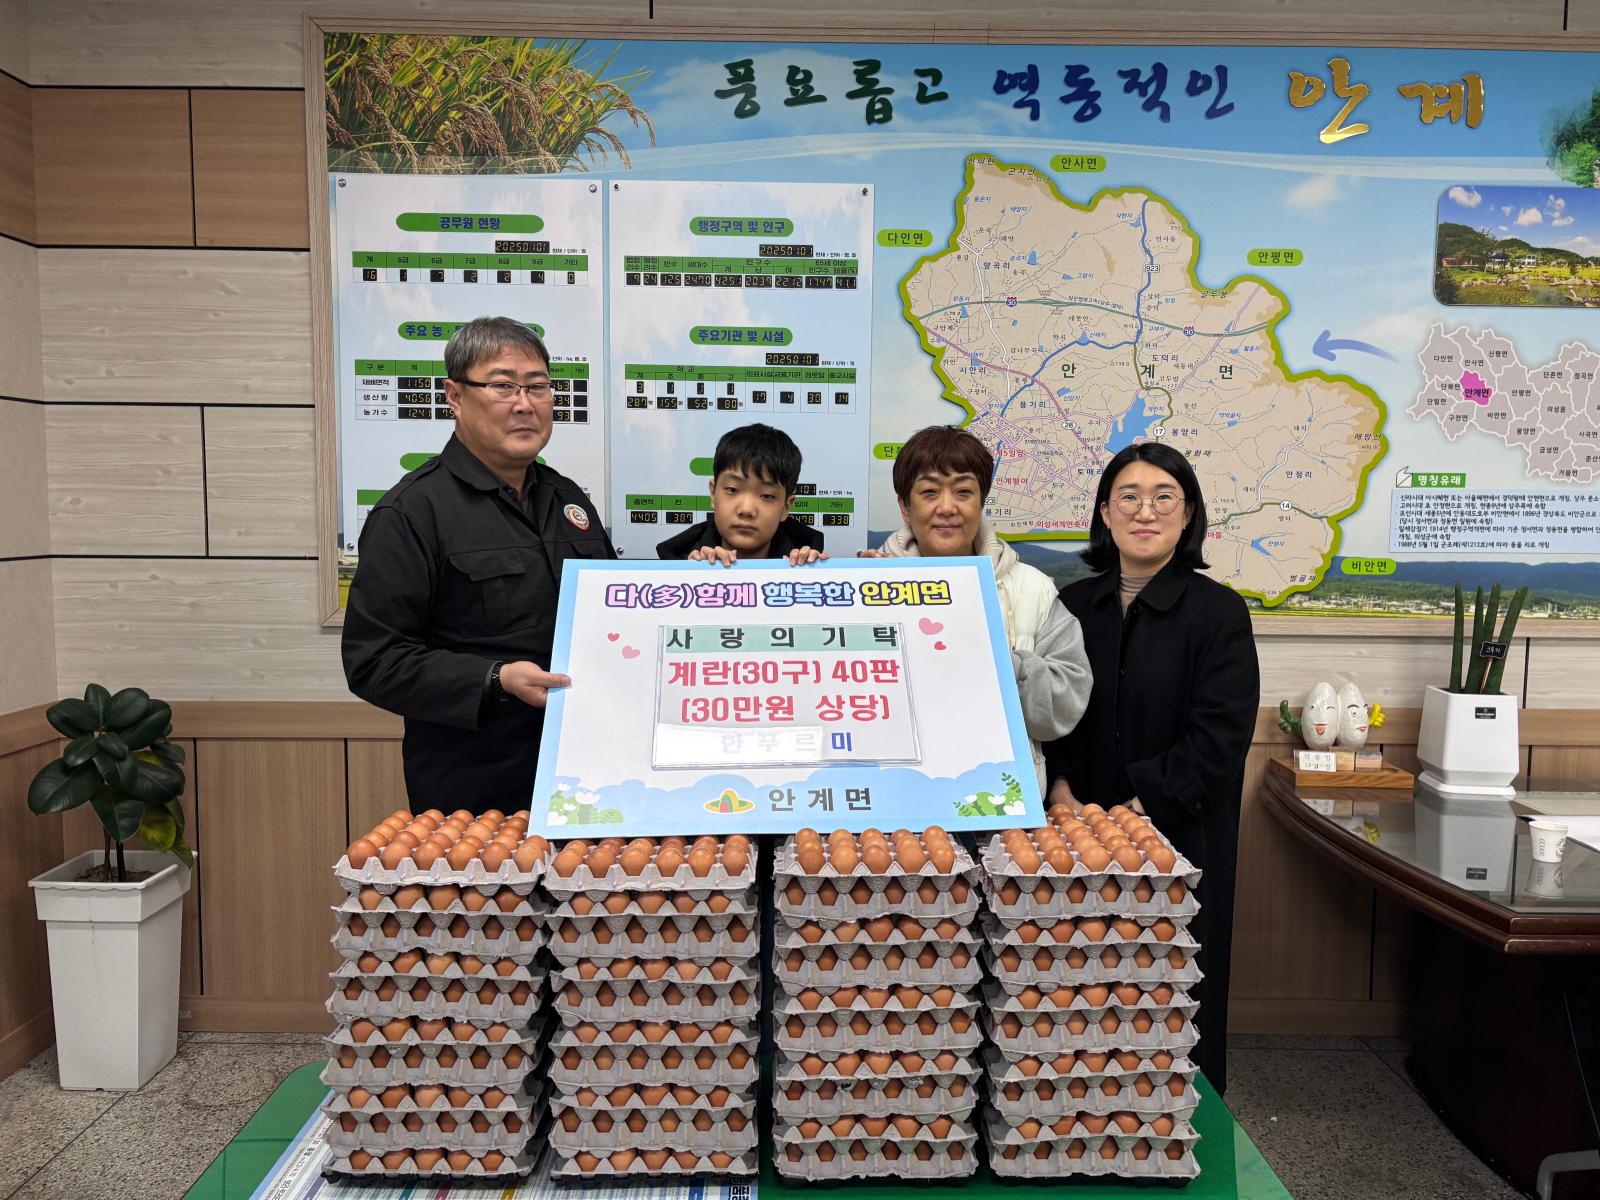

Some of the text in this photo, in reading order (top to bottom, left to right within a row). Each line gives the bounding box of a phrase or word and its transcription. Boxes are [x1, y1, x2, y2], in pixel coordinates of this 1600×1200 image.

[714, 58, 949, 125] 풍요롭고
[993, 62, 1235, 123] 역동적인
[1061, 157, 1097, 170] 안사면
[440, 216, 500, 230] 공무원 현황
[698, 220, 785, 233] 행정구역 및 인구
[887, 232, 922, 244] 다인면
[760, 245, 813, 256] 20250101
[563, 258, 578, 266] 기타
[1258, 252, 1294, 264] 안평면
[644, 274, 657, 284] 24
[685, 275, 711, 285] 2470
[745, 277, 772, 286] 2039
[405, 324, 427, 337] 주요
[698, 329, 784, 342] 주요기관 및 시설
[766, 354, 819, 365] 20250101
[1151, 354, 1178, 362] 도덕리
[1433, 355, 1453, 363] 다인면
[1464, 359, 1484, 367] 안사면
[1061, 363, 1233, 379] 안 계 면
[408, 379, 431, 388] 1150
[1440, 383, 1461, 391] 단북면
[405, 394, 431, 403] 4056
[809, 393, 821, 403] 30
[1464, 388, 1490, 398] 안계면
[1511, 389, 1531, 397] 안평면
[660, 398, 677, 408] 155
[694, 399, 707, 408] 52
[1427, 397, 1447, 406] 단밀면
[408, 408, 570, 421] 1241 93
[1449, 414, 1468, 422] 구천면
[1487, 411, 1507, 420] 비안면
[1171, 428, 1198, 436] 봉양리
[1578, 431, 1598, 439] 사곡면
[1286, 470, 1312, 478] 안정리
[1418, 474, 1461, 485] 명칭유래
[631, 513, 657, 522] 4405
[830, 515, 849, 525] 338
[1351, 560, 1388, 572] 비안면
[605, 580, 952, 608] 다(多)함께 행복한 안계면
[667, 658, 900, 687] 계란(30구) 40판
[681, 694, 890, 723] (30만원 상당)
[768, 787, 872, 812] 안계면
